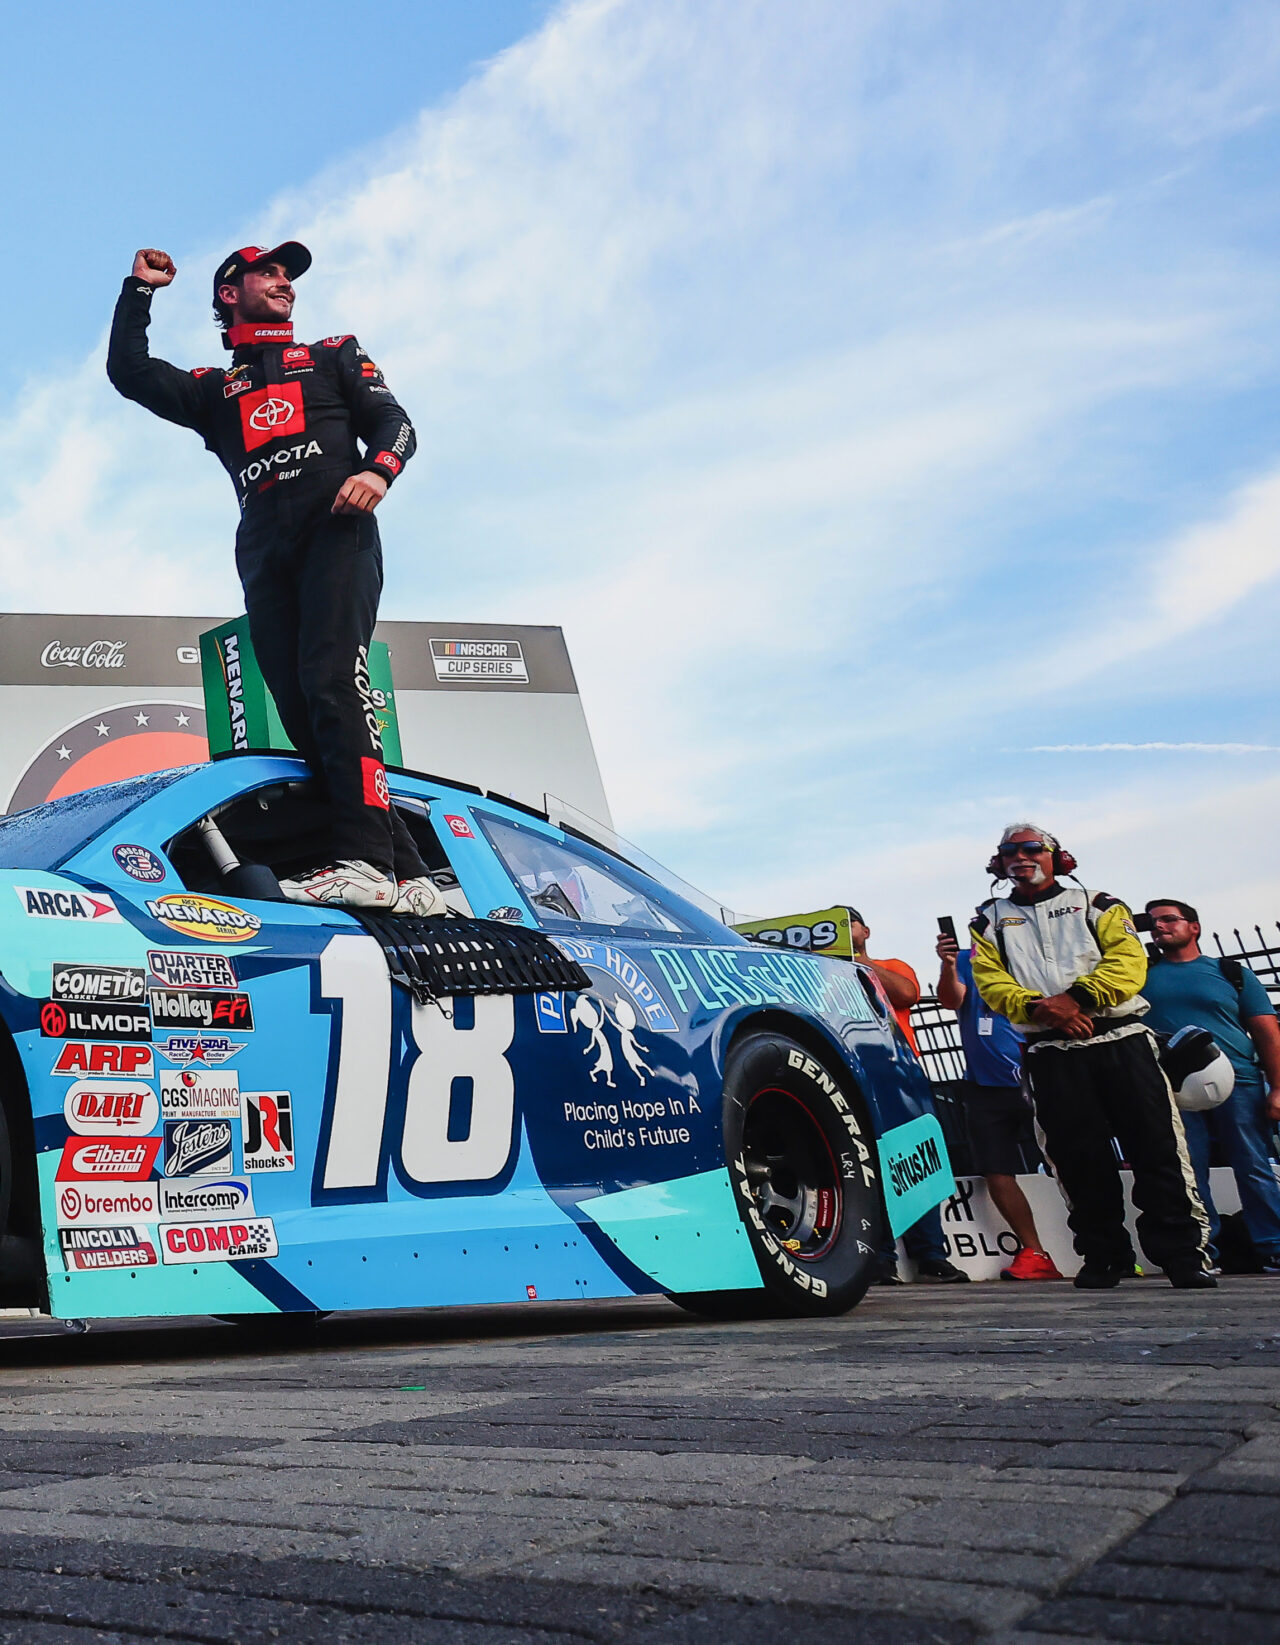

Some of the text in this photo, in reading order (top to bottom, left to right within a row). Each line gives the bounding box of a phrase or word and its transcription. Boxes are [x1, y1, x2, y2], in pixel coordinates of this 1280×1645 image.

[392, 422, 412, 457] TOYOTA
[239, 440, 323, 487] TOYOTA
[279, 468, 302, 480] GRAY
[40, 640, 128, 668] Coca-Cola
[460, 644, 508, 656] NASCAR
[447, 661, 513, 674] CUP SERIES
[125, 864, 162, 880] SALUTES
[26, 890, 87, 918] ARCA
[1048, 907, 1072, 919] ARCA
[145, 900, 262, 931] MENARDS
[150, 952, 227, 973] QUARTER
[55, 971, 144, 997] COMETIC
[170, 968, 235, 987] MASTER
[605, 946, 667, 1022] HOPE
[61, 993, 97, 1001] GASKET
[152, 991, 213, 1026] Holley
[69, 1012, 151, 1033] ILMOR
[169, 1038, 230, 1050] FIVE STAR
[206, 1051, 225, 1059] Bodies
[55, 1043, 152, 1073] ARP
[320, 934, 515, 1189] 18
[75, 1091, 151, 1119] DART
[181, 1109, 217, 1117] MANUFACTURE
[220, 1109, 240, 1117] INSTALL
[563, 1095, 702, 1125] Placing Hope In A
[787, 1050, 876, 1188] GENERAL
[165, 1120, 231, 1177] Jostens
[583, 1126, 691, 1150] Child's Future
[72, 1144, 147, 1172] Eibach
[244, 1155, 286, 1170] shocks
[84, 1193, 153, 1213] brembo
[164, 1190, 240, 1210] Intercomp
[734, 1152, 828, 1299] GENERAL
[61, 1228, 135, 1249] LINCOLN
[166, 1224, 249, 1254] COMP
[228, 1243, 268, 1256] CAMS
[81, 1249, 149, 1267] WELDERS
